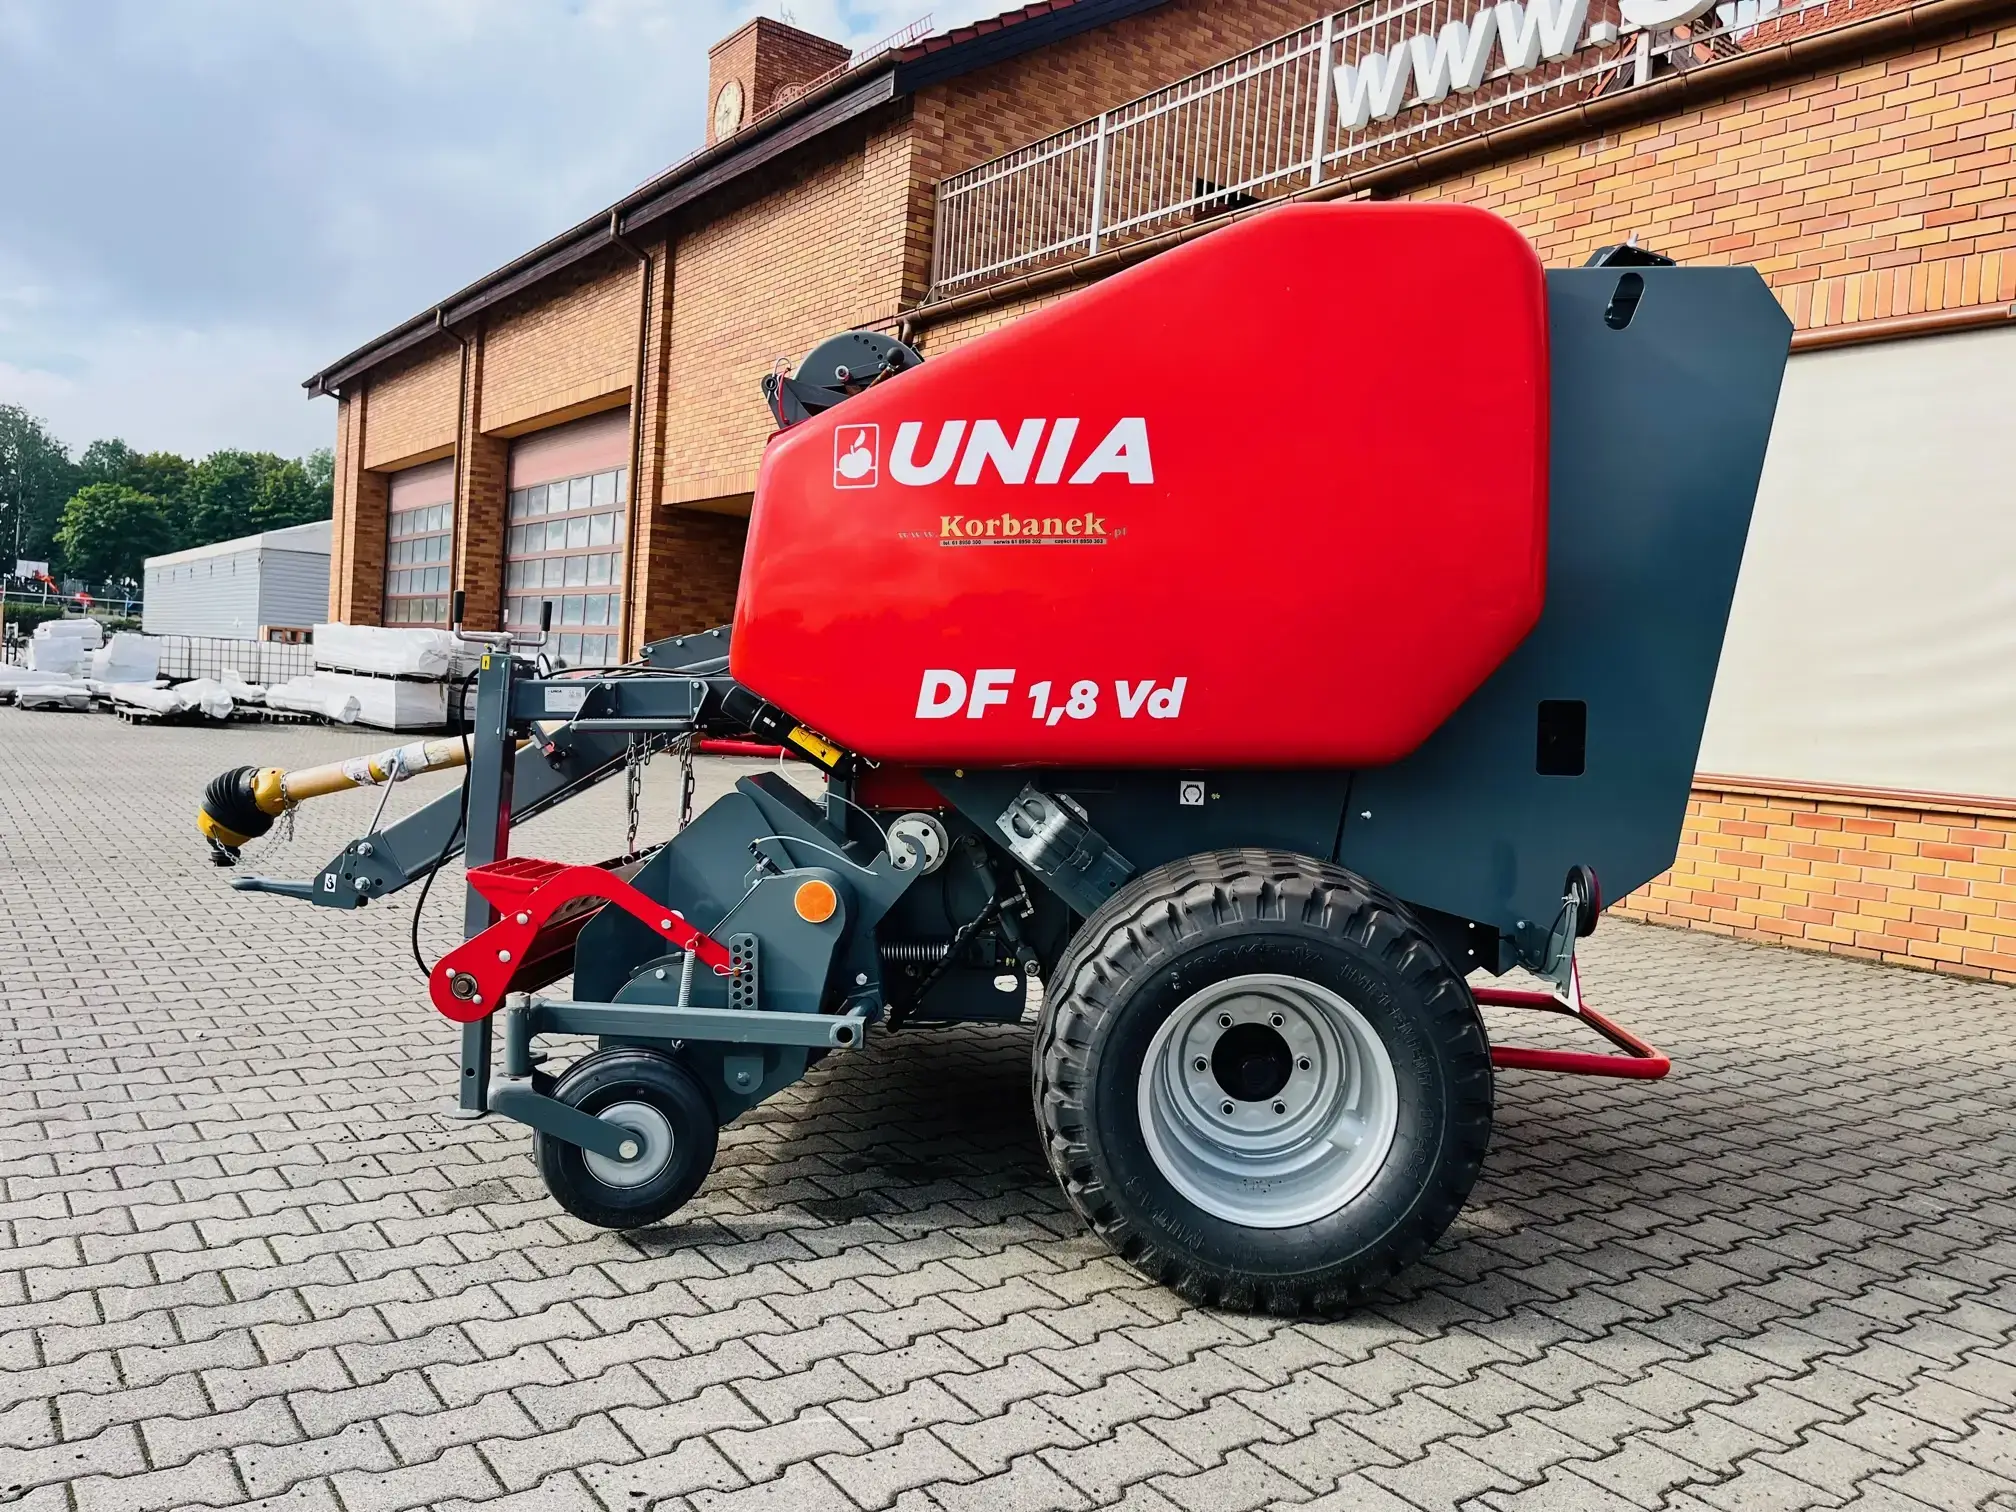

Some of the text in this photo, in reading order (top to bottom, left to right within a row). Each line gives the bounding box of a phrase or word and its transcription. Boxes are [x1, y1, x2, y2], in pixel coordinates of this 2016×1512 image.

[889, 418, 1153, 486] UNIA
[916, 669, 1187, 725] DF 1,8 Vd
